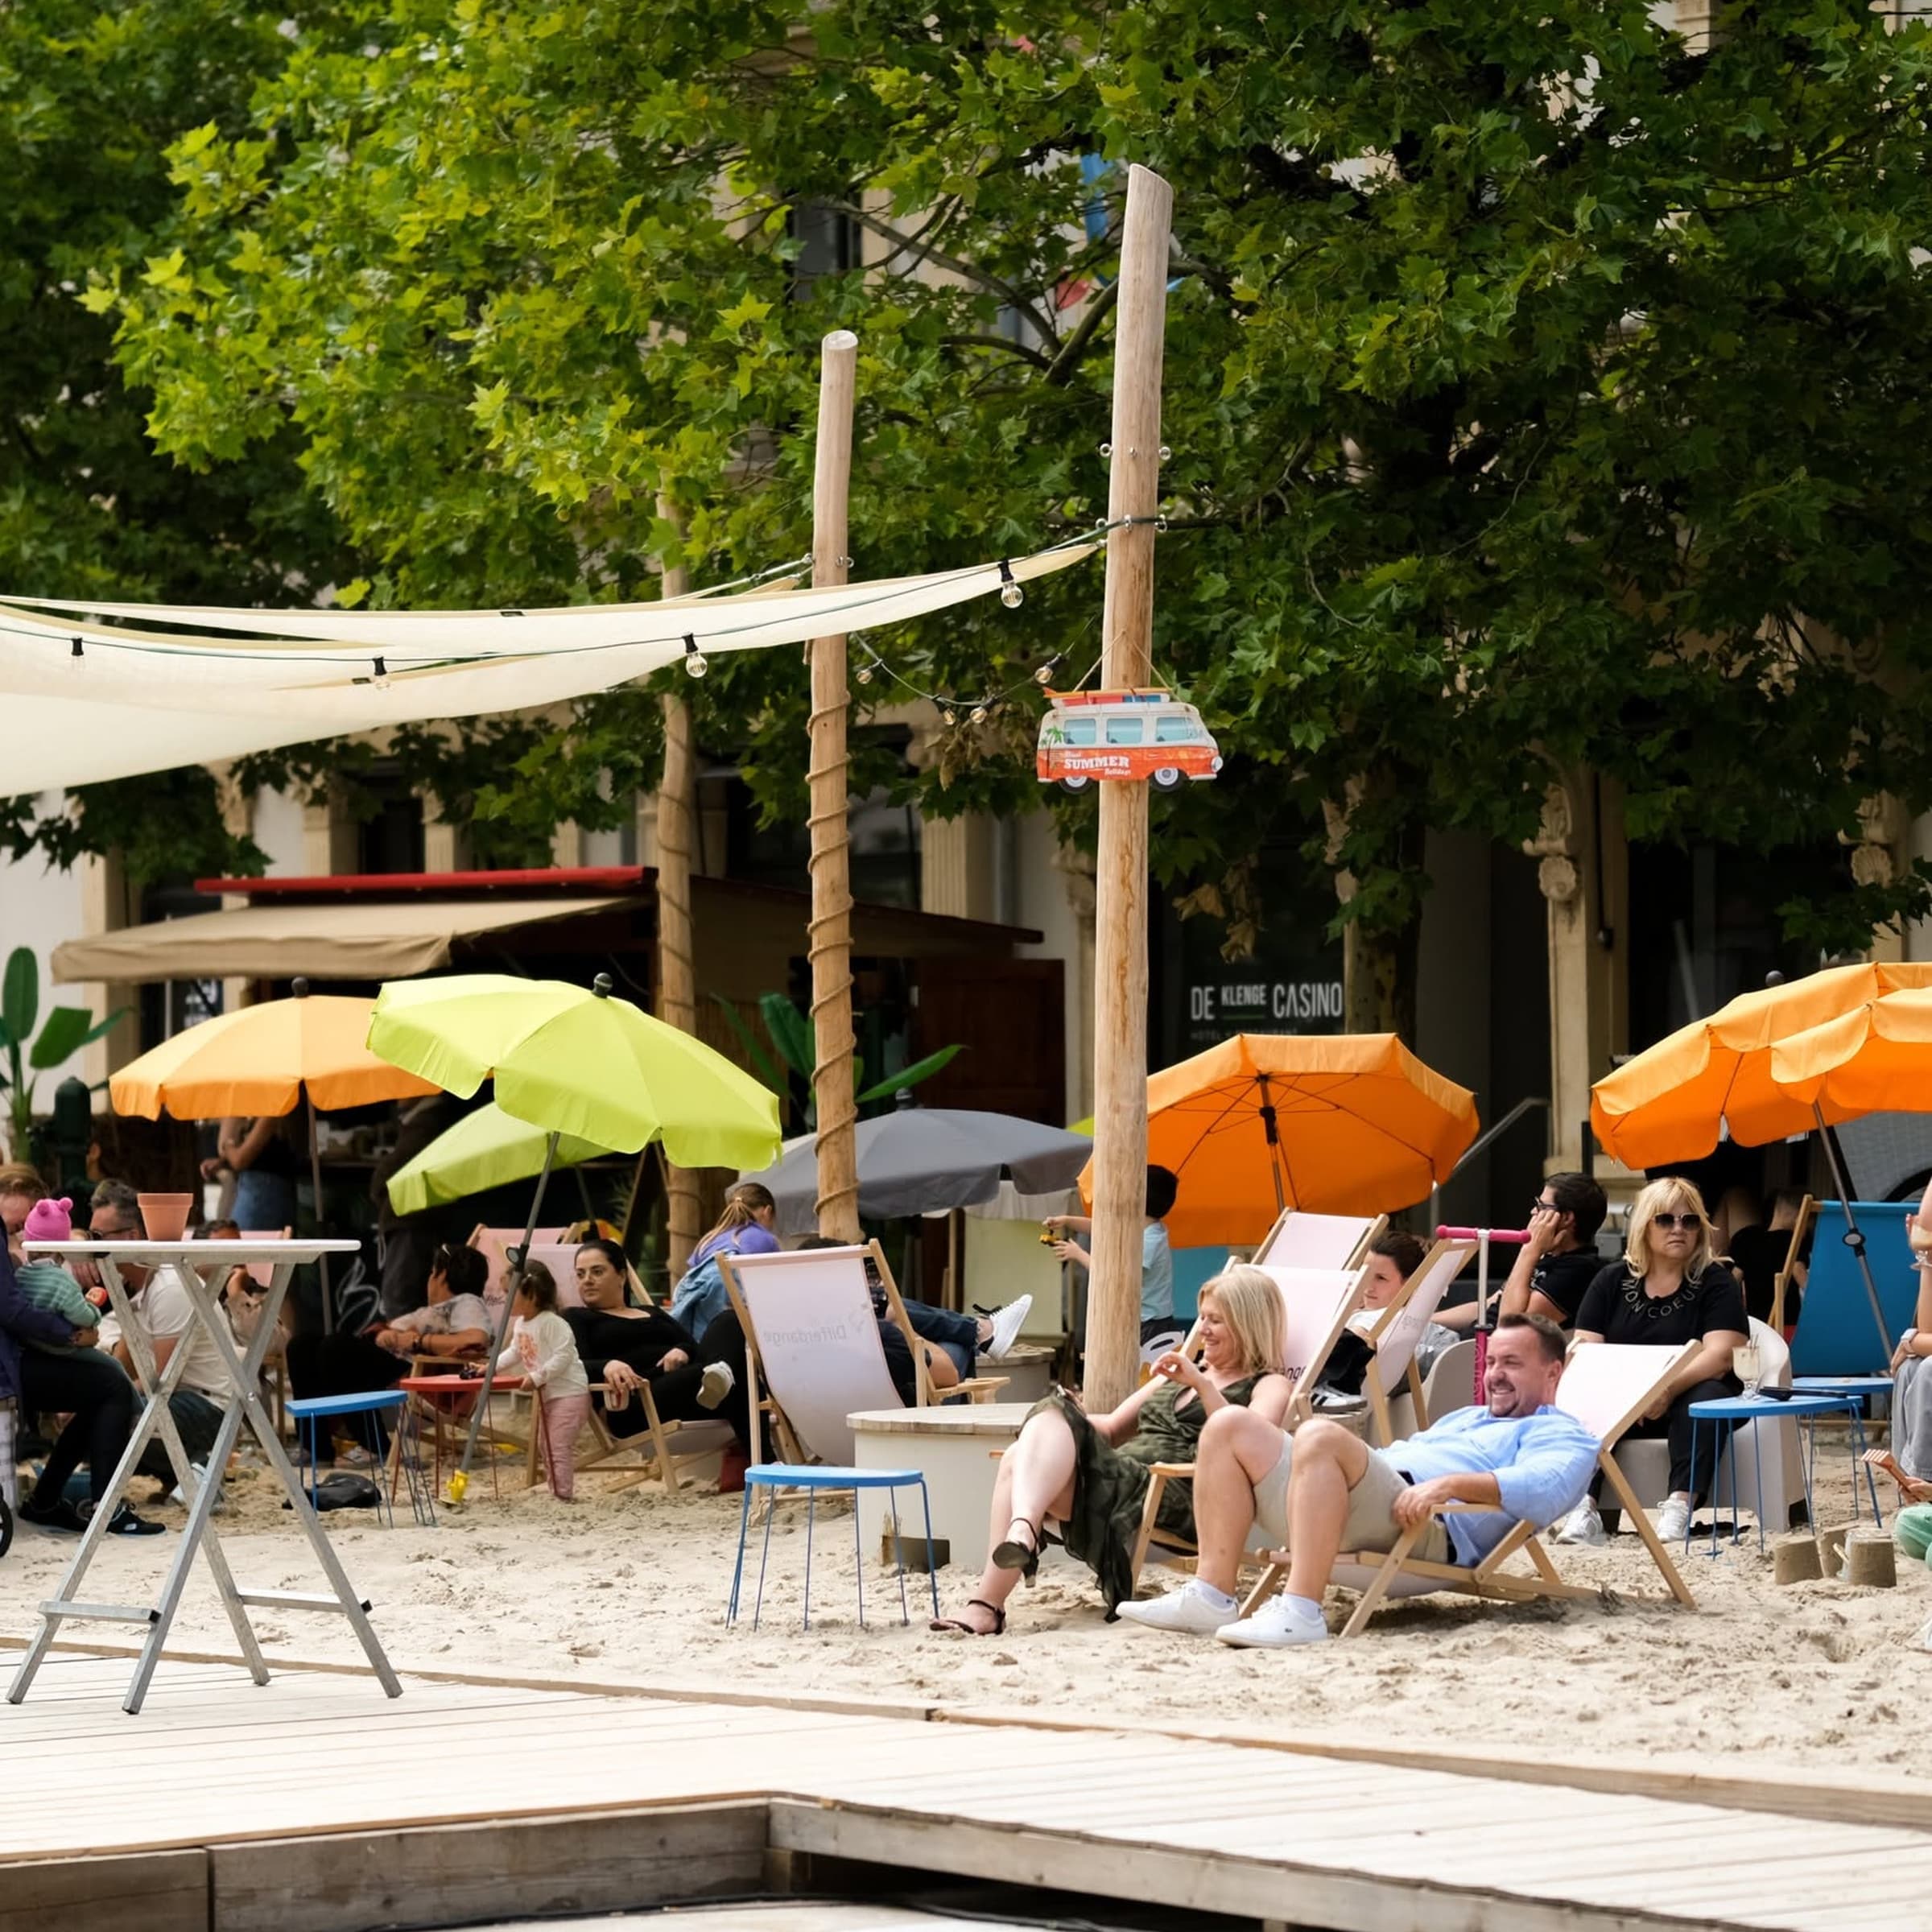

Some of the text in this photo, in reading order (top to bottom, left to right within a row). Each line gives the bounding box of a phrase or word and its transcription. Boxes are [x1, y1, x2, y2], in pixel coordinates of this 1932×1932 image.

[1064, 756, 1129, 770] SUMMER
[1191, 982, 1343, 1021] DE KLENGE CASINO
[1621, 1278, 1645, 1313] MON
